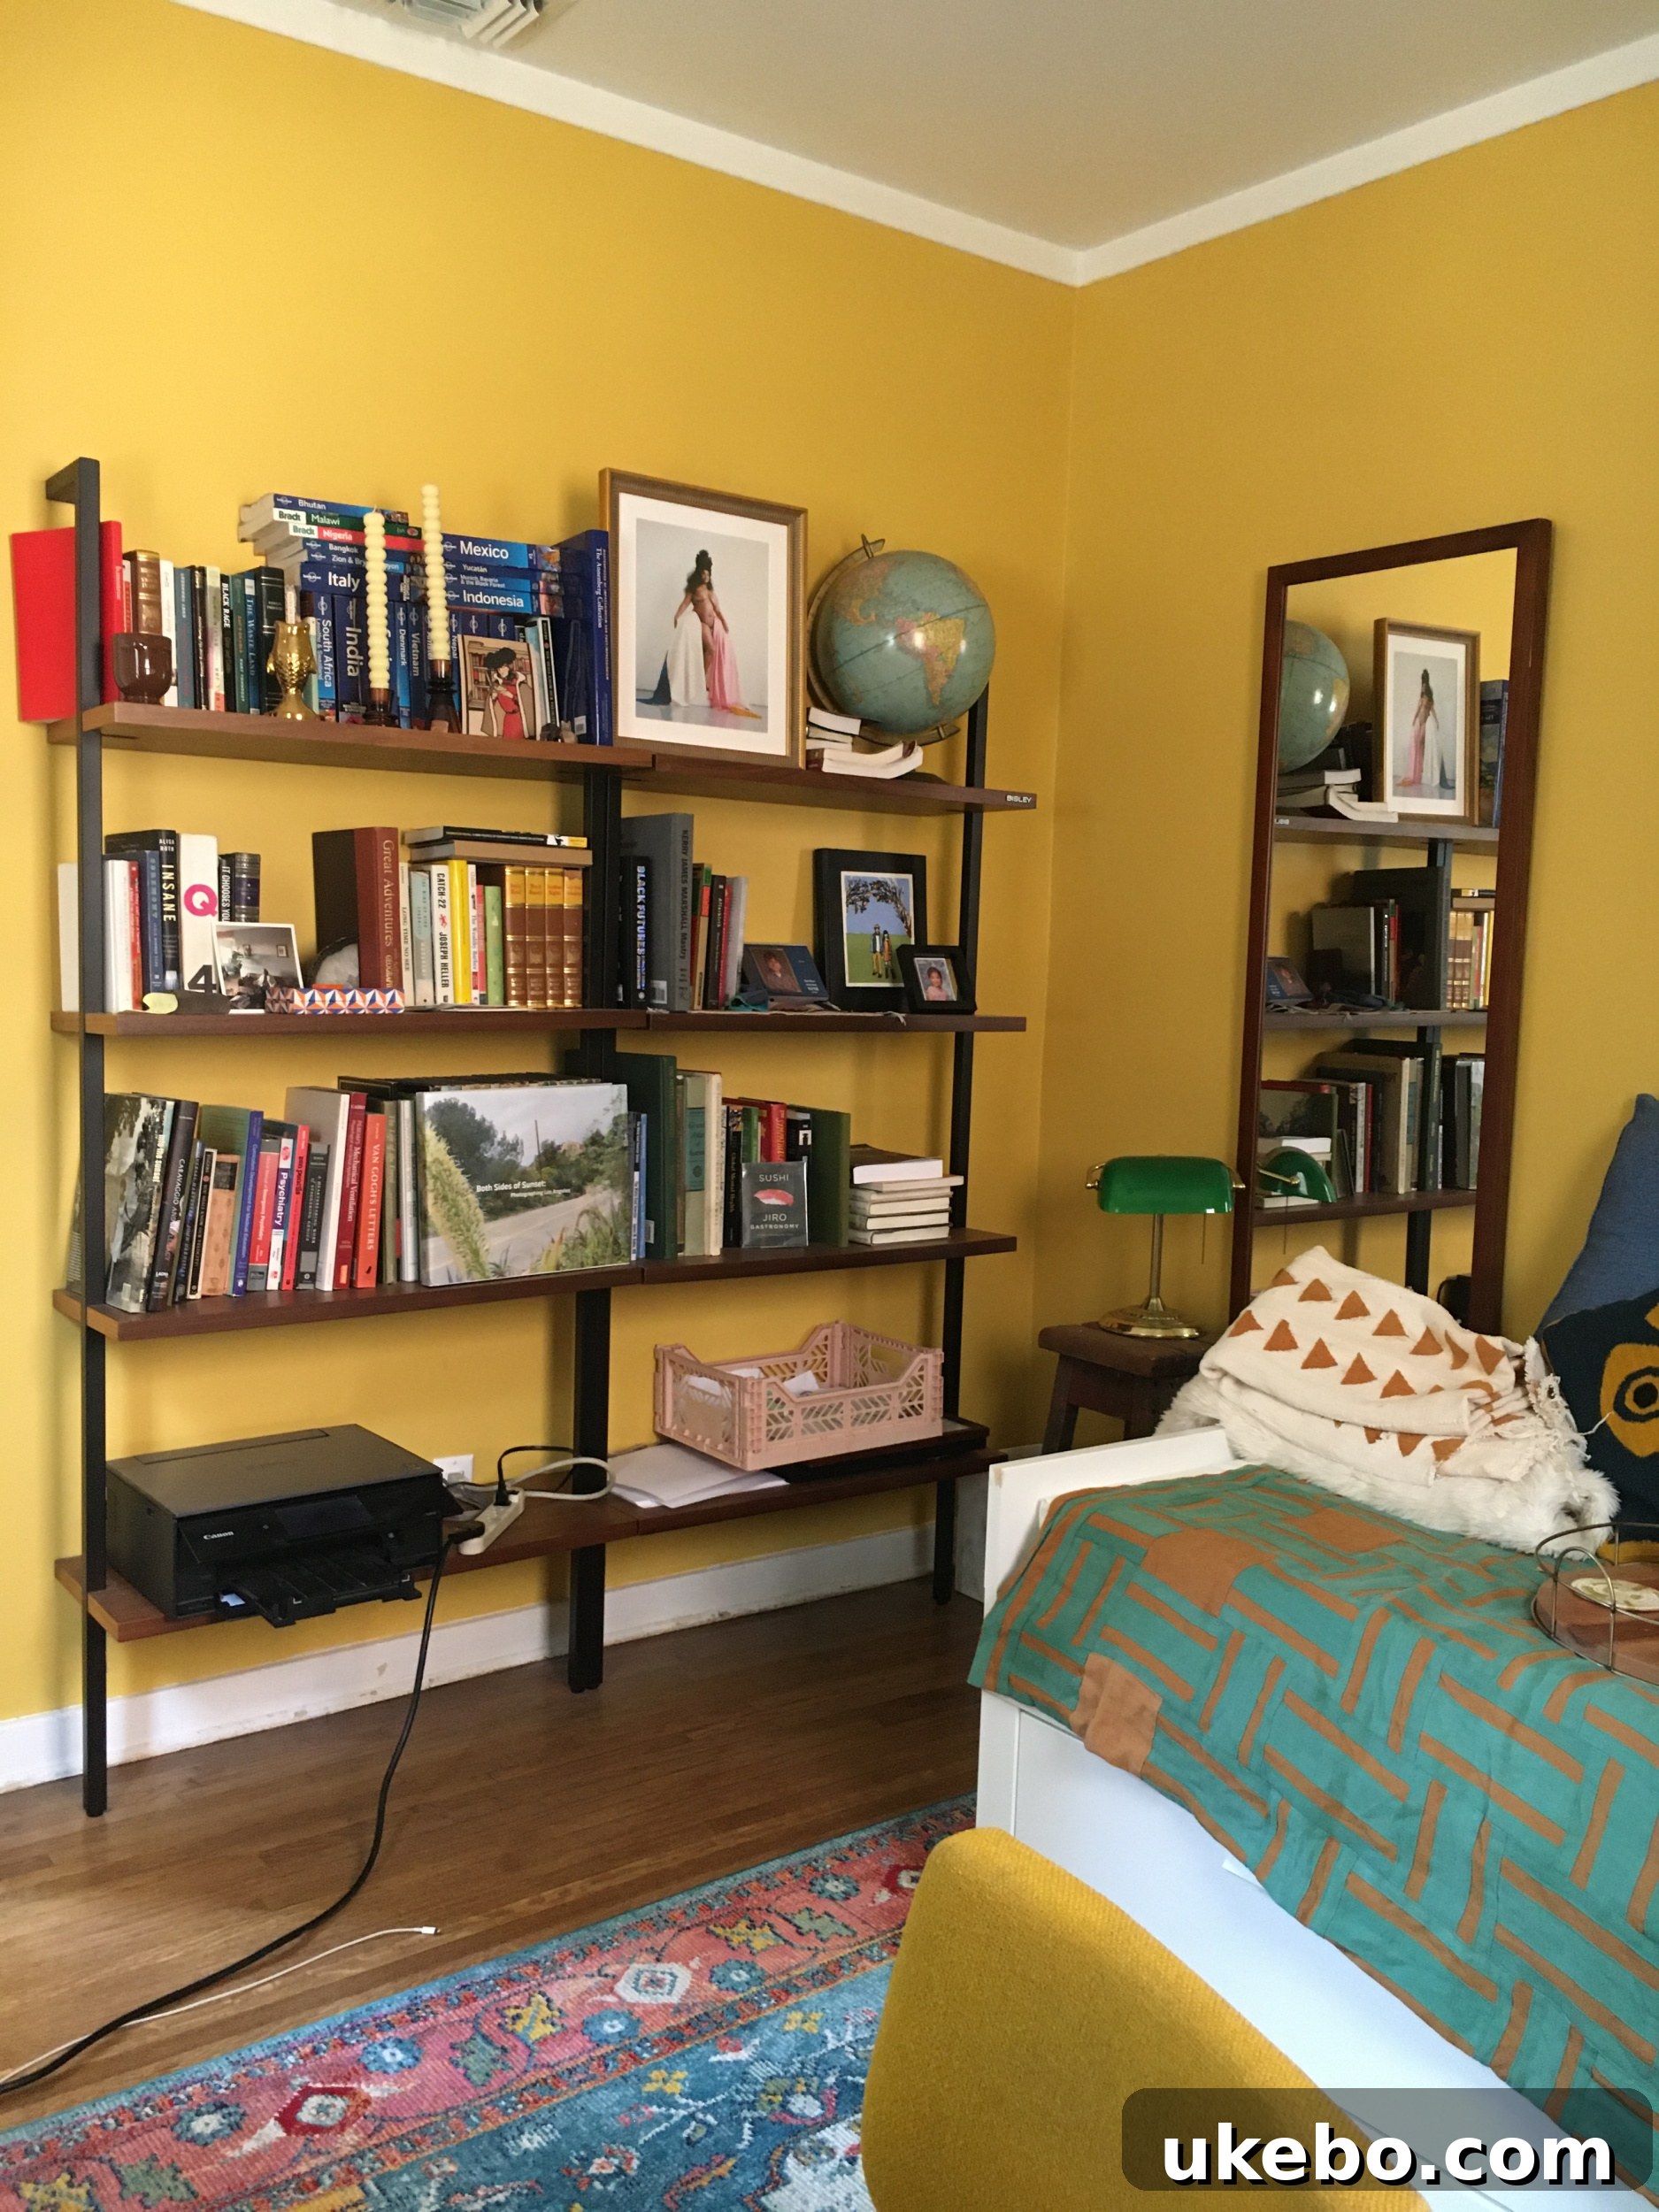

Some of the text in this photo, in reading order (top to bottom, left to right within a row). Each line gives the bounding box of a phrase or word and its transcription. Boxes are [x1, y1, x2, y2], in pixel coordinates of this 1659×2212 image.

[279, 511, 301, 521] Bradt
[298, 498, 326, 511] Bhutan
[293, 525, 315, 535] Bradt
[311, 514, 340, 526] Malawi
[323, 529, 353, 541] Nigeria
[328, 543, 358, 554] Bangkok
[332, 555, 347, 564] Zion
[459, 540, 509, 559] Mexico
[328, 572, 361, 592] Italy
[221, 582, 230, 611] BLACK
[463, 590, 524, 608] Indonesia
[321, 619, 334, 687] South Africa
[345, 626, 364, 677] India
[411, 633, 420, 677] Vietnam
[1006, 794, 1033, 804] BISLEY
[382, 839, 396, 873] Great
[161, 864, 176, 922] INSANE
[221, 865, 231, 923] IT CHOOSES YOU
[637, 866, 646, 903] BLACK
[183, 884, 219, 917] Q
[383, 879, 396, 948] Adventures
[436, 872, 450, 988] CATCH-22 JOSEPH HELLER
[637, 904, 646, 956] FUTURES
[403, 947, 409, 957] NO
[679, 933, 687, 960] Mastry
[187, 964, 218, 993] 4
[250, 1144, 258, 1171] Curriculum
[349, 1147, 360, 1185] Mechanical
[371, 1143, 380, 1164] VAN
[152, 1159, 163, 1183] sunset
[172, 1158, 186, 1205] CARAVAGGIO
[295, 1170, 303, 1194] pencils
[758, 1173, 789, 1183] SUSHI
[247, 1172, 257, 1204] Development
[274, 1171, 289, 1226] Psychiatry
[369, 1166, 379, 1205] GOGH'S
[476, 1184, 493, 1193] Both
[494, 1182, 512, 1192] Sides
[522, 1180, 547, 1189] Sunset:
[346, 1186, 357, 1222] Ventilation
[763, 1213, 787, 1222] JIRO
[257, 1216, 266, 1240] Psychiatry
[366, 1208, 377, 1250] LETTERS
[203, 1529, 234, 1541] Canon
